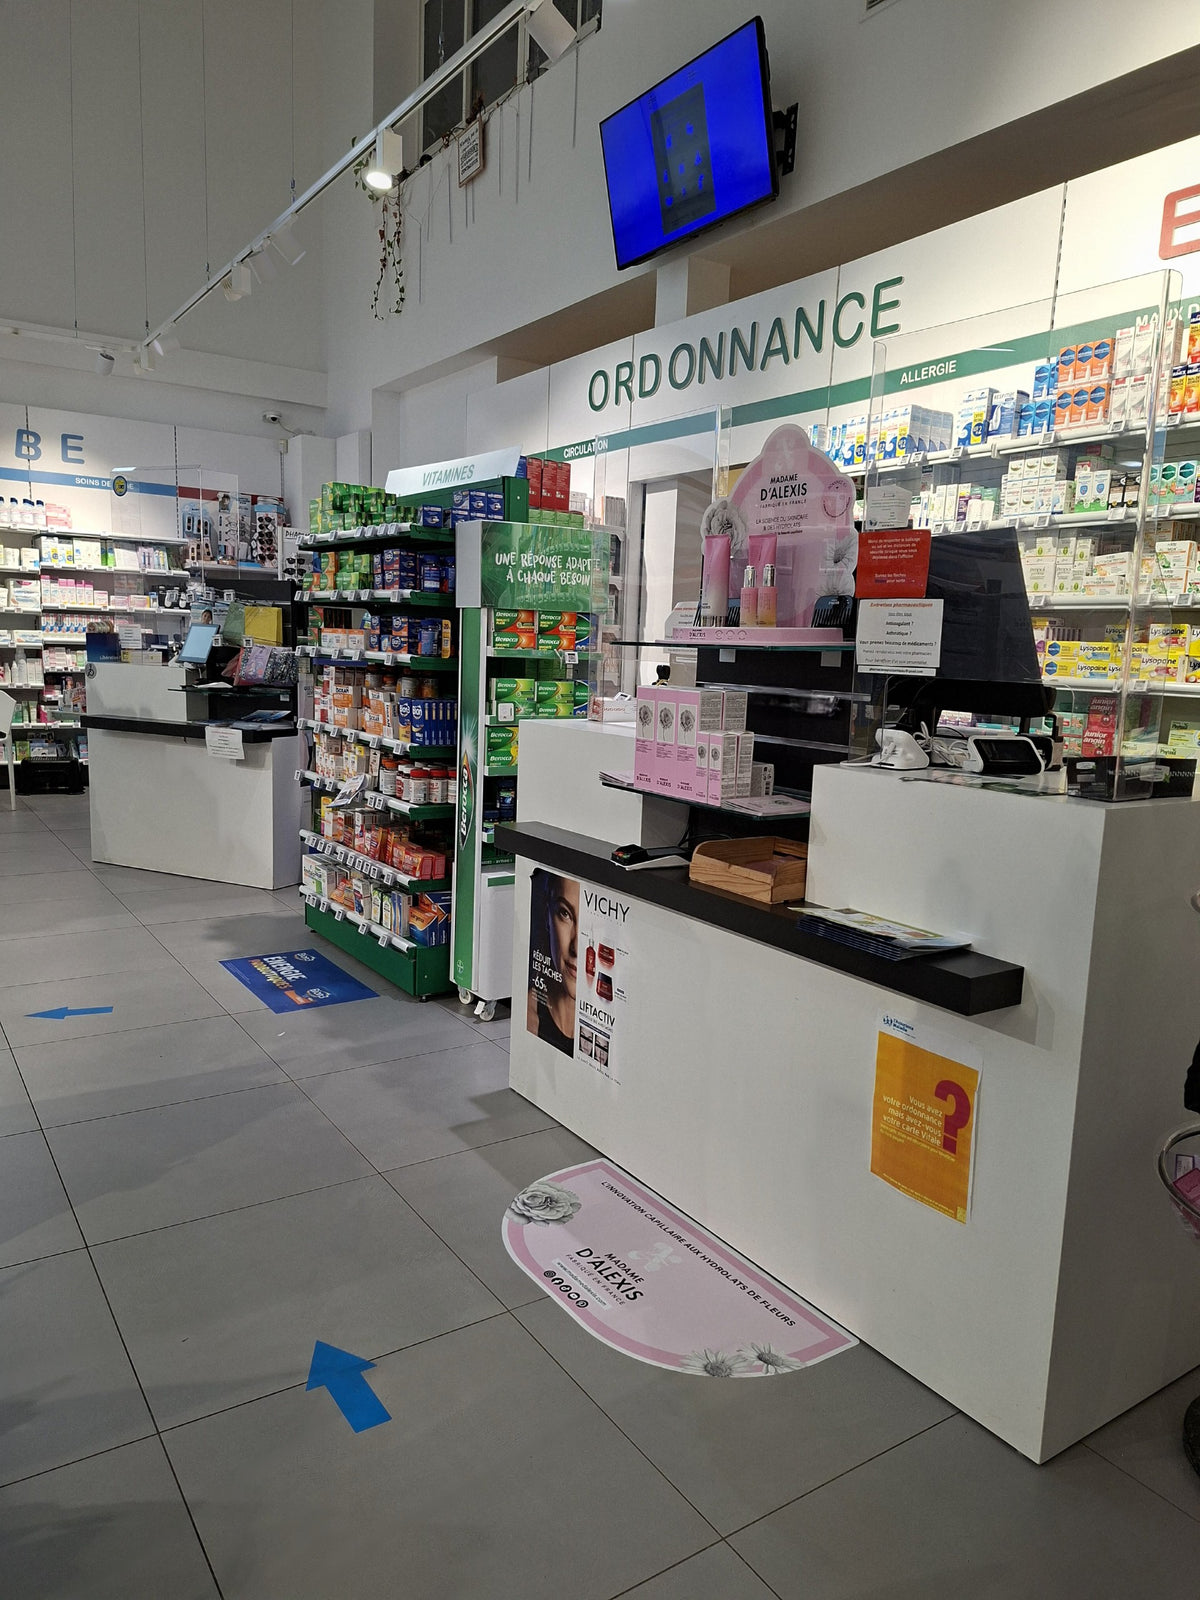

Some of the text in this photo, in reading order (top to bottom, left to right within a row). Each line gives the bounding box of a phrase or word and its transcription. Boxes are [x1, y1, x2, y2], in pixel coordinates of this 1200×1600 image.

[588, 276, 904, 412] ORDONNANCE
[900, 360, 957, 385] ALLERGIE
[563, 438, 608, 458] CIRCULATON
[75, 477, 100, 486] SOINS
[423, 464, 475, 486] VITAMINES
[770, 474, 798, 484] MADAME
[761, 483, 807, 501] D'ALEXIS
[495, 552, 516, 565] UNE
[521, 551, 562, 568] RÉPONSE
[506, 565, 591, 586] À CHAQUE BESOIN
[1083, 737, 1106, 745] angin
[1084, 731, 1108, 739] junior
[584, 890, 630, 922] VICHY
[533, 949, 551, 966] RÉDUIT
[533, 960, 562, 982] LES TACHES
[580, 999, 615, 1027] LIFTACTIV
[883, 1095, 942, 1127] votre ordonnance
[910, 1096, 942, 1117] Vous avez
[883, 1115, 941, 1146] votre carte Vitale
[888, 1107, 941, 1136] mais avez-vous
[601, 1181, 796, 1327] L'INNOVATION CAPILLAIRE AUX HYDROLATS DE FLEURS
[575, 1247, 644, 1300] D'ALEXIS
[604, 1253, 644, 1283] MADAME
[601, 1284, 626, 1305] FRANCE
